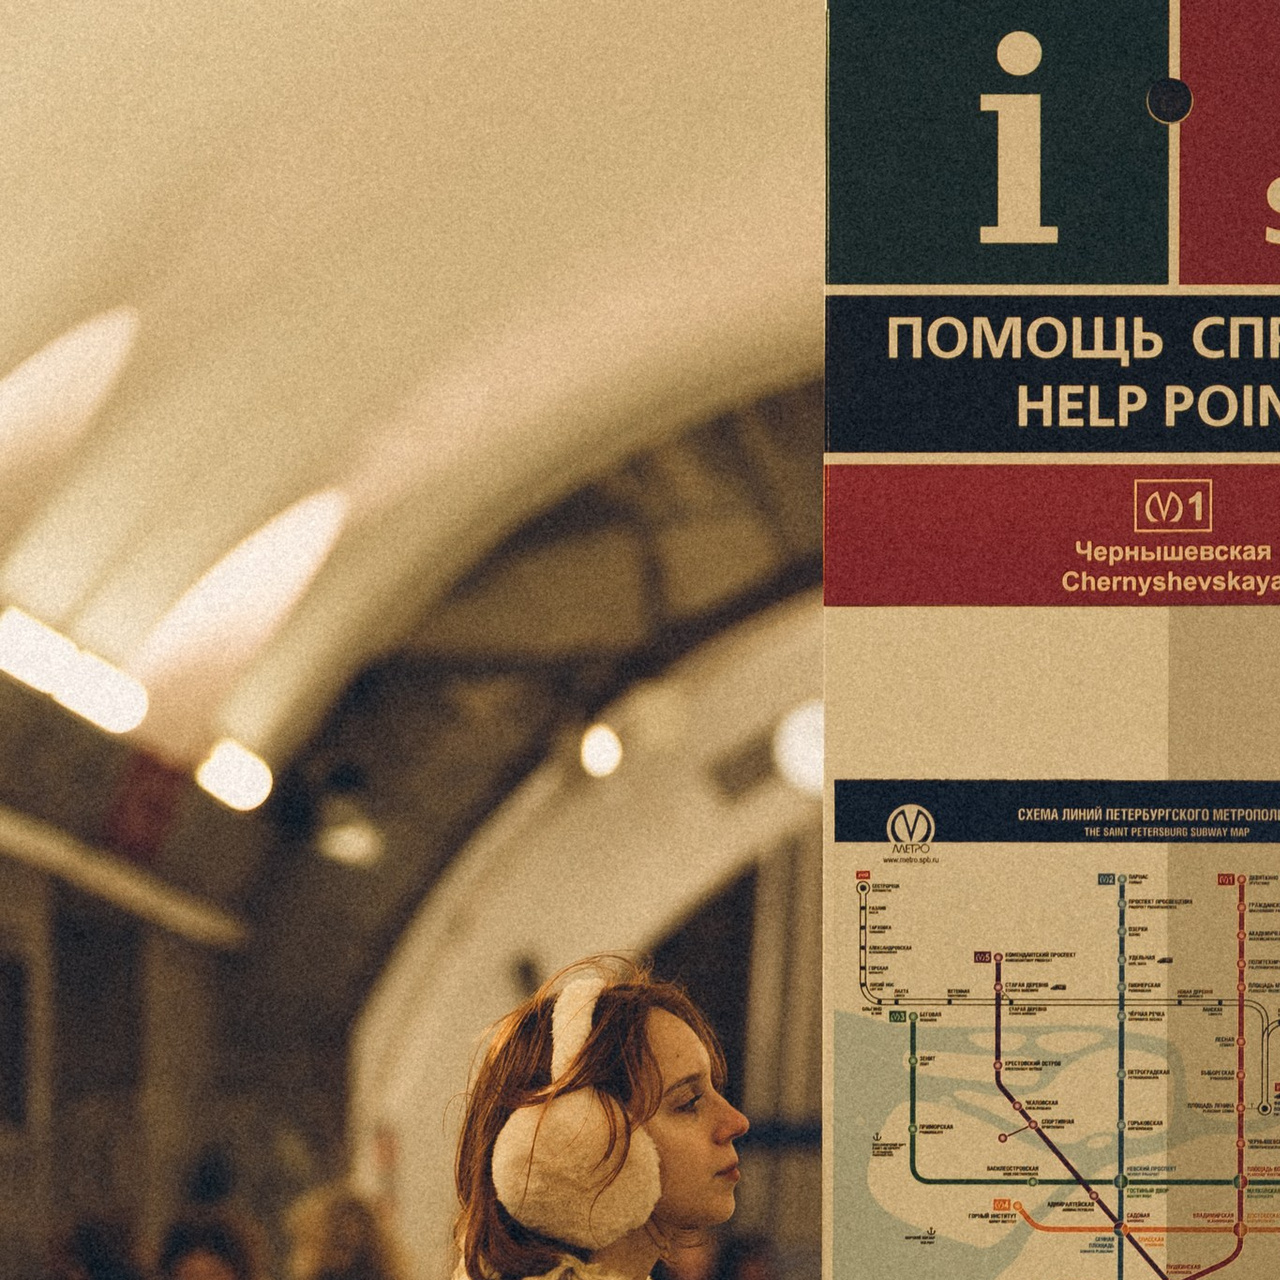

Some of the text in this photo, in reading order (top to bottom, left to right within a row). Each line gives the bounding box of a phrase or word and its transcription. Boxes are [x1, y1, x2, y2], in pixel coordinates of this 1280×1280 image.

[887, 316, 1164, 366] ПОМОЩЬ
[1016, 385, 1148, 427] HELP
[1075, 541, 1272, 562] Чернышевская
[1018, 807, 1059, 821] СХЕМА
[1062, 807, 1102, 821] ЛИНИЙ
[1106, 807, 1209, 821] ПЕТЕРБУРГСКОГО
[1084, 826, 1251, 837] THE SAINT PETERSBURG SUBWAY MAP
[891, 844, 931, 854] МЕТРО
[882, 855, 940, 865] www.metro.spb.ru
